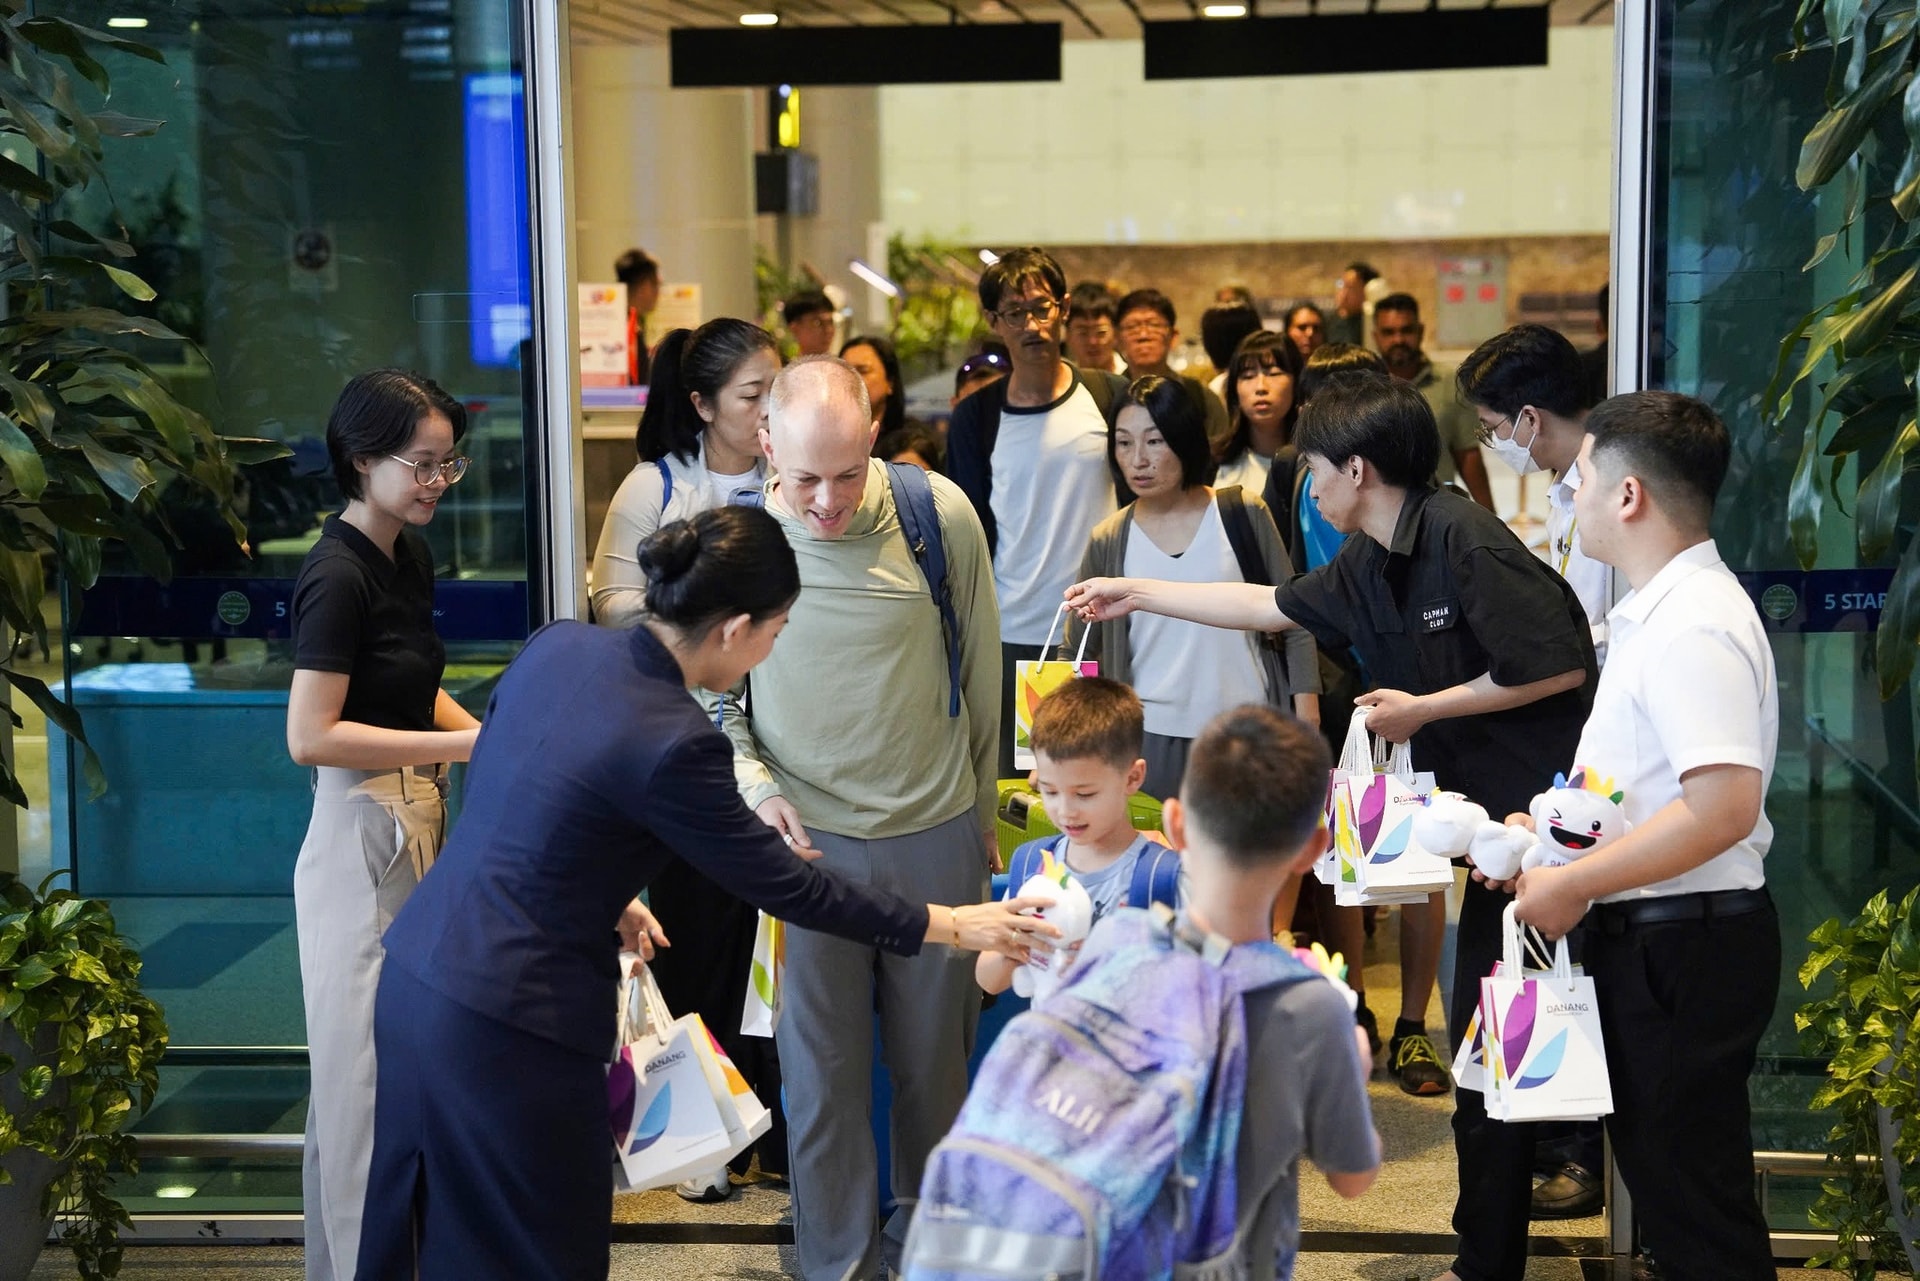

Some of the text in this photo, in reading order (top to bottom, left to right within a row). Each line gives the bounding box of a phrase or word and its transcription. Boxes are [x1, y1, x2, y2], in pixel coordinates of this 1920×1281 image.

[275, 601, 286, 617] 5
[1825, 593, 1836, 610] 5
[1546, 1003, 1588, 1013] DANANG
